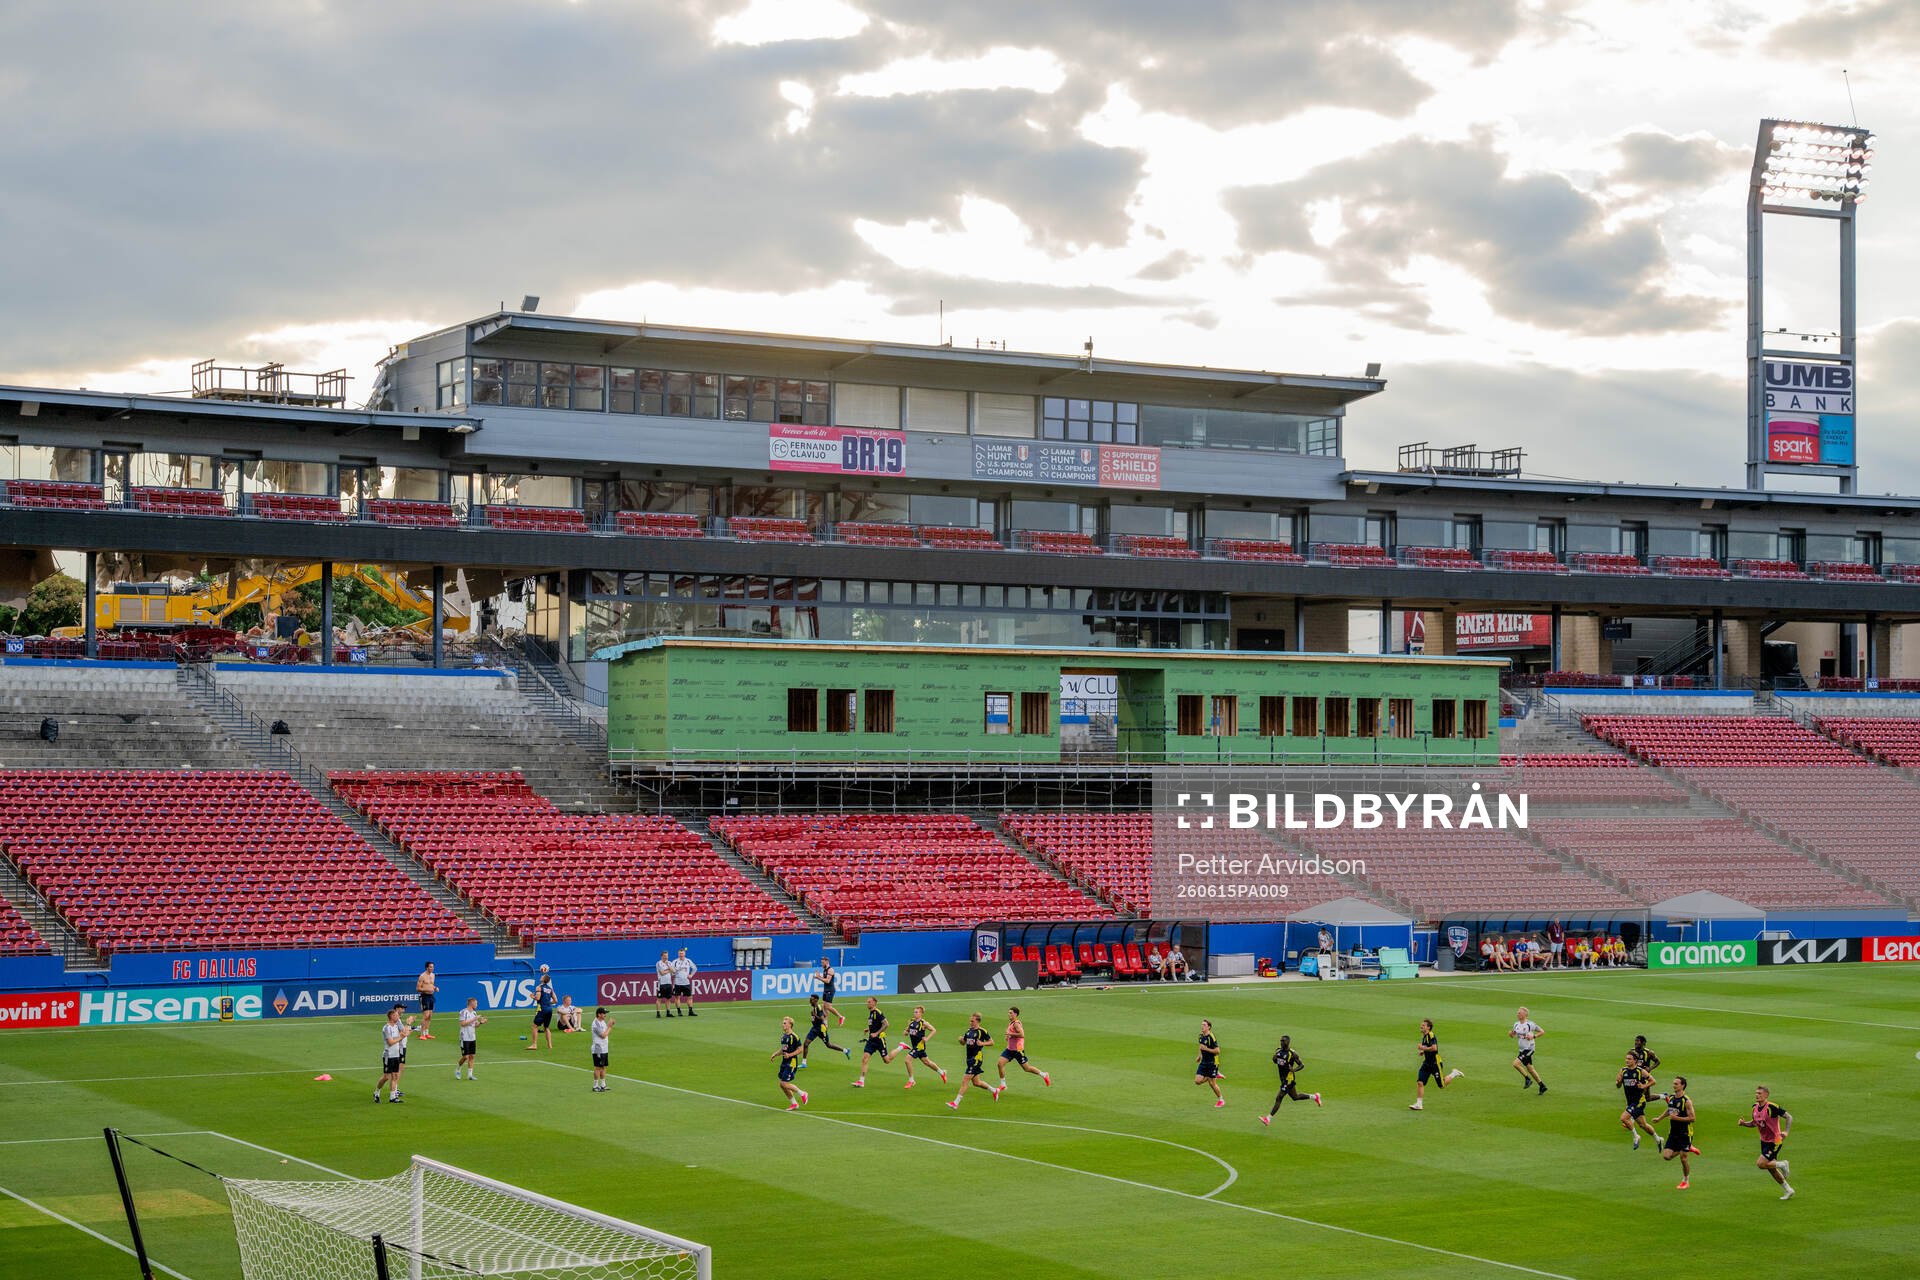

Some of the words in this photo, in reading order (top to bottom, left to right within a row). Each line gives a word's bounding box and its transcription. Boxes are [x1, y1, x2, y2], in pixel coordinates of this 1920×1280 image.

[1766, 363, 1852, 388] UMB
[1766, 393, 1852, 411] BANK
[790, 441, 838, 452] FERNANDO
[790, 450, 826, 459] CLAVIJO
[841, 435, 903, 473] BR19
[1050, 448, 1075, 456] LAMAR
[1773, 436, 1812, 456] spark
[975, 444, 985, 474] 1997
[987, 452, 1012, 460] HUNT
[1040, 448, 1049, 478] 2016
[1050, 455, 1075, 464] HUNT
[987, 468, 1033, 477] CHAMPIONS
[1101, 451, 1110, 480] 2016
[1112, 459, 1157, 472] SHIELD
[1050, 471, 1096, 480] CHAMPIONS
[1112, 471, 1157, 483] WINNERS
[1456, 613, 1495, 634] RNER
[1497, 613, 1533, 632] KICK
[8, 643, 23, 651] 109
[1473, 635, 1495, 644] NACHOS
[1498, 634, 1519, 642] SNACKS
[352, 651, 365, 660] 108
[1660, 944, 1746, 965] aramco
[1773, 938, 1847, 964] KIA
[172, 959, 191, 980] FC
[198, 957, 257, 979] DALLAS
[478, 978, 556, 1009] VIS
[673, 977, 749, 995] RWAYS
[292, 988, 348, 1011] ADI
